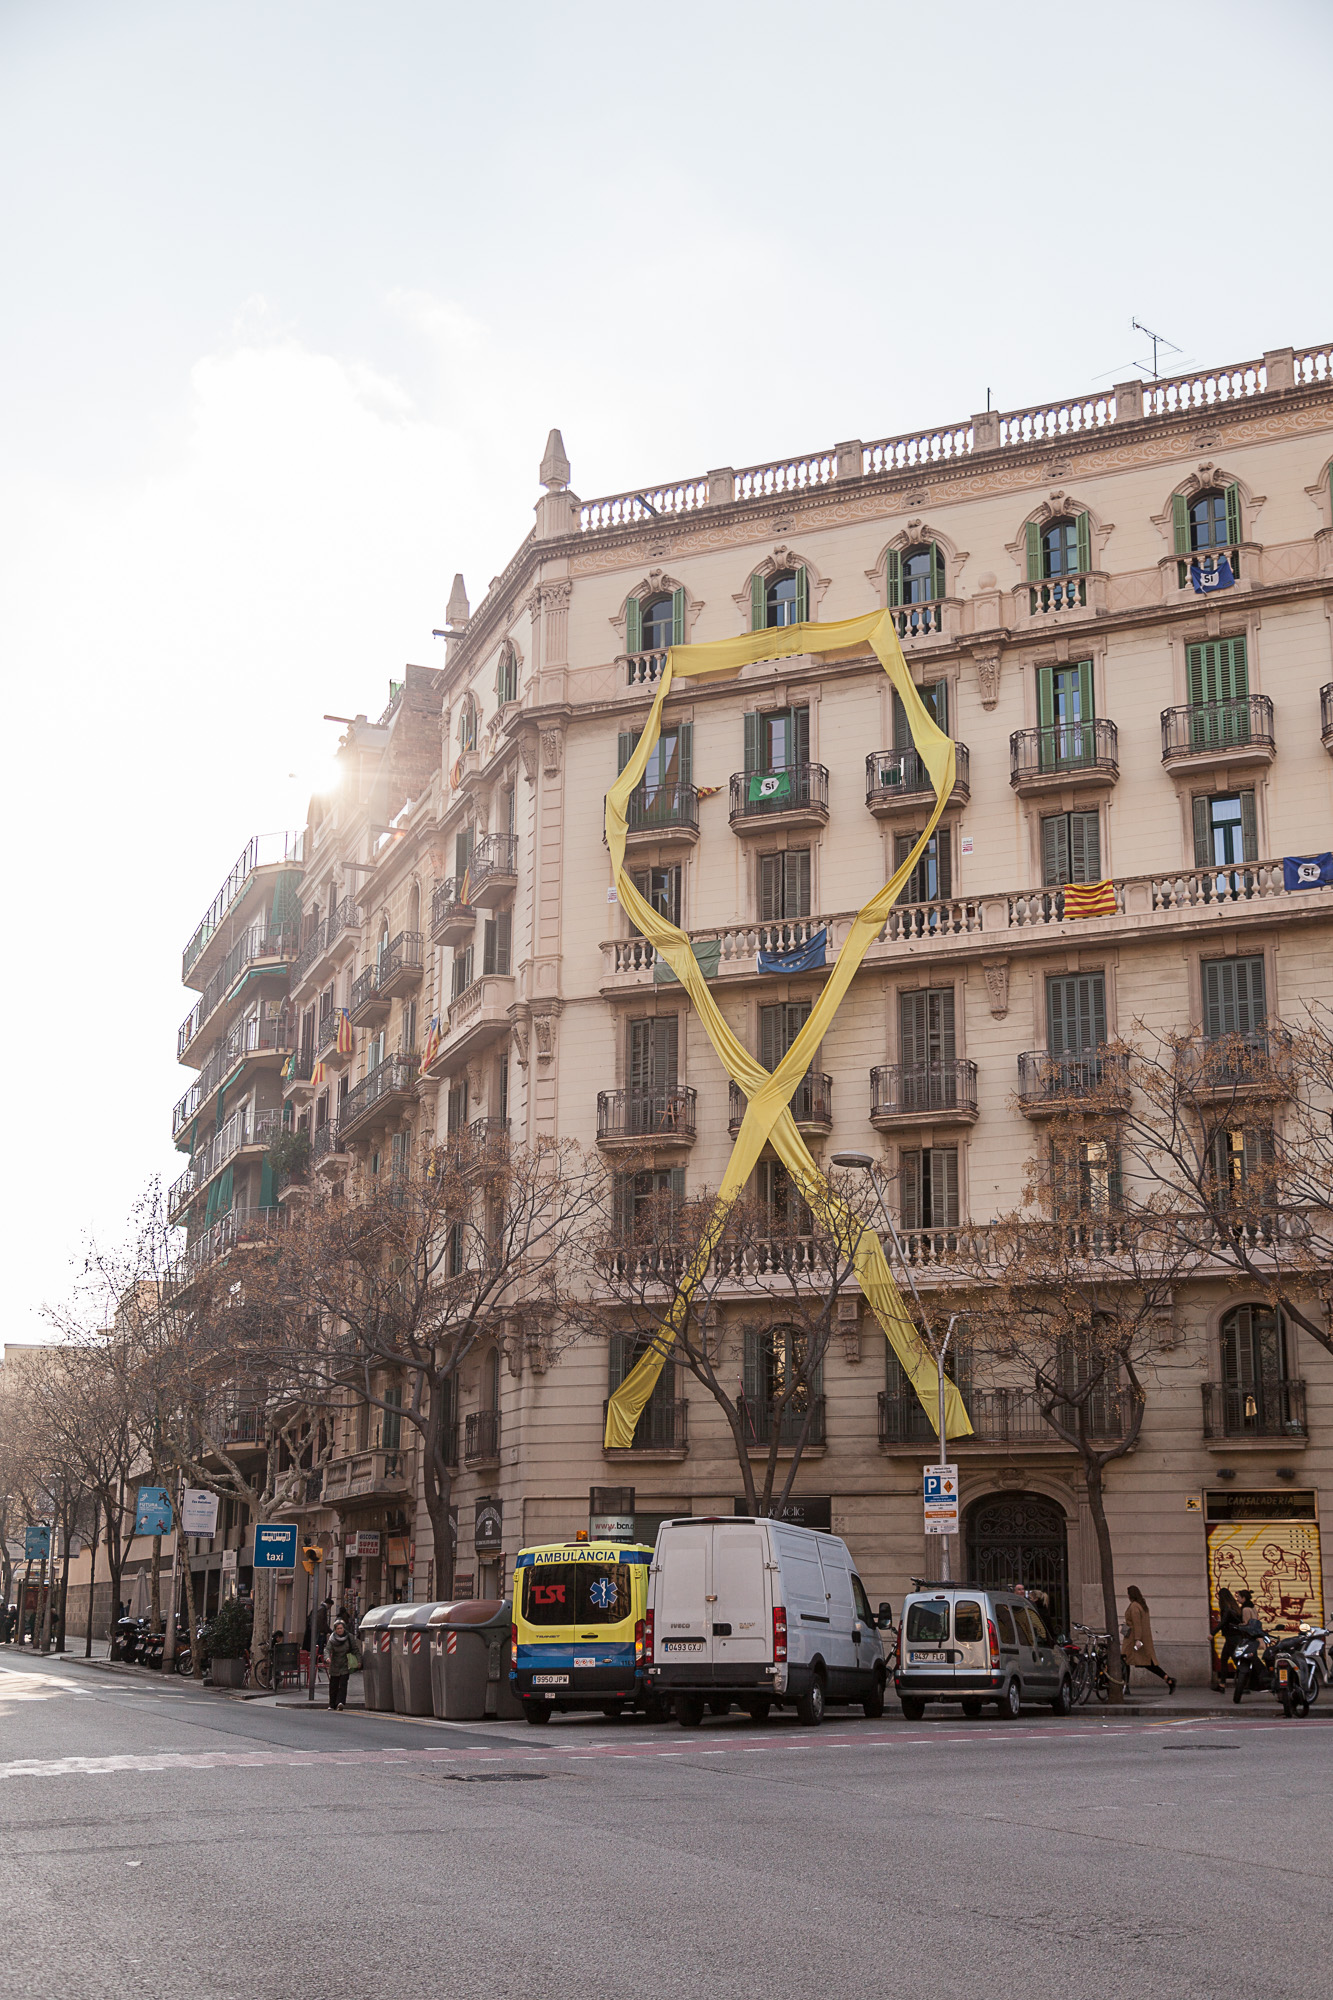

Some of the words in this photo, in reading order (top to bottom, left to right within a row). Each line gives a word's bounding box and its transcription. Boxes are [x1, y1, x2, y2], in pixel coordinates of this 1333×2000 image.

[765, 781, 774, 790] Sí
[928, 1478, 937, 1493] P
[1228, 1496, 1294, 1505] CANSALADERIA
[266, 1552, 284, 1561] taxi
[535, 1550, 616, 1563] AMBULÀNCIA
[668, 1643, 687, 1651] 0493
[688, 1643, 702, 1651] GXJ
[914, 1652, 929, 1660] 9437
